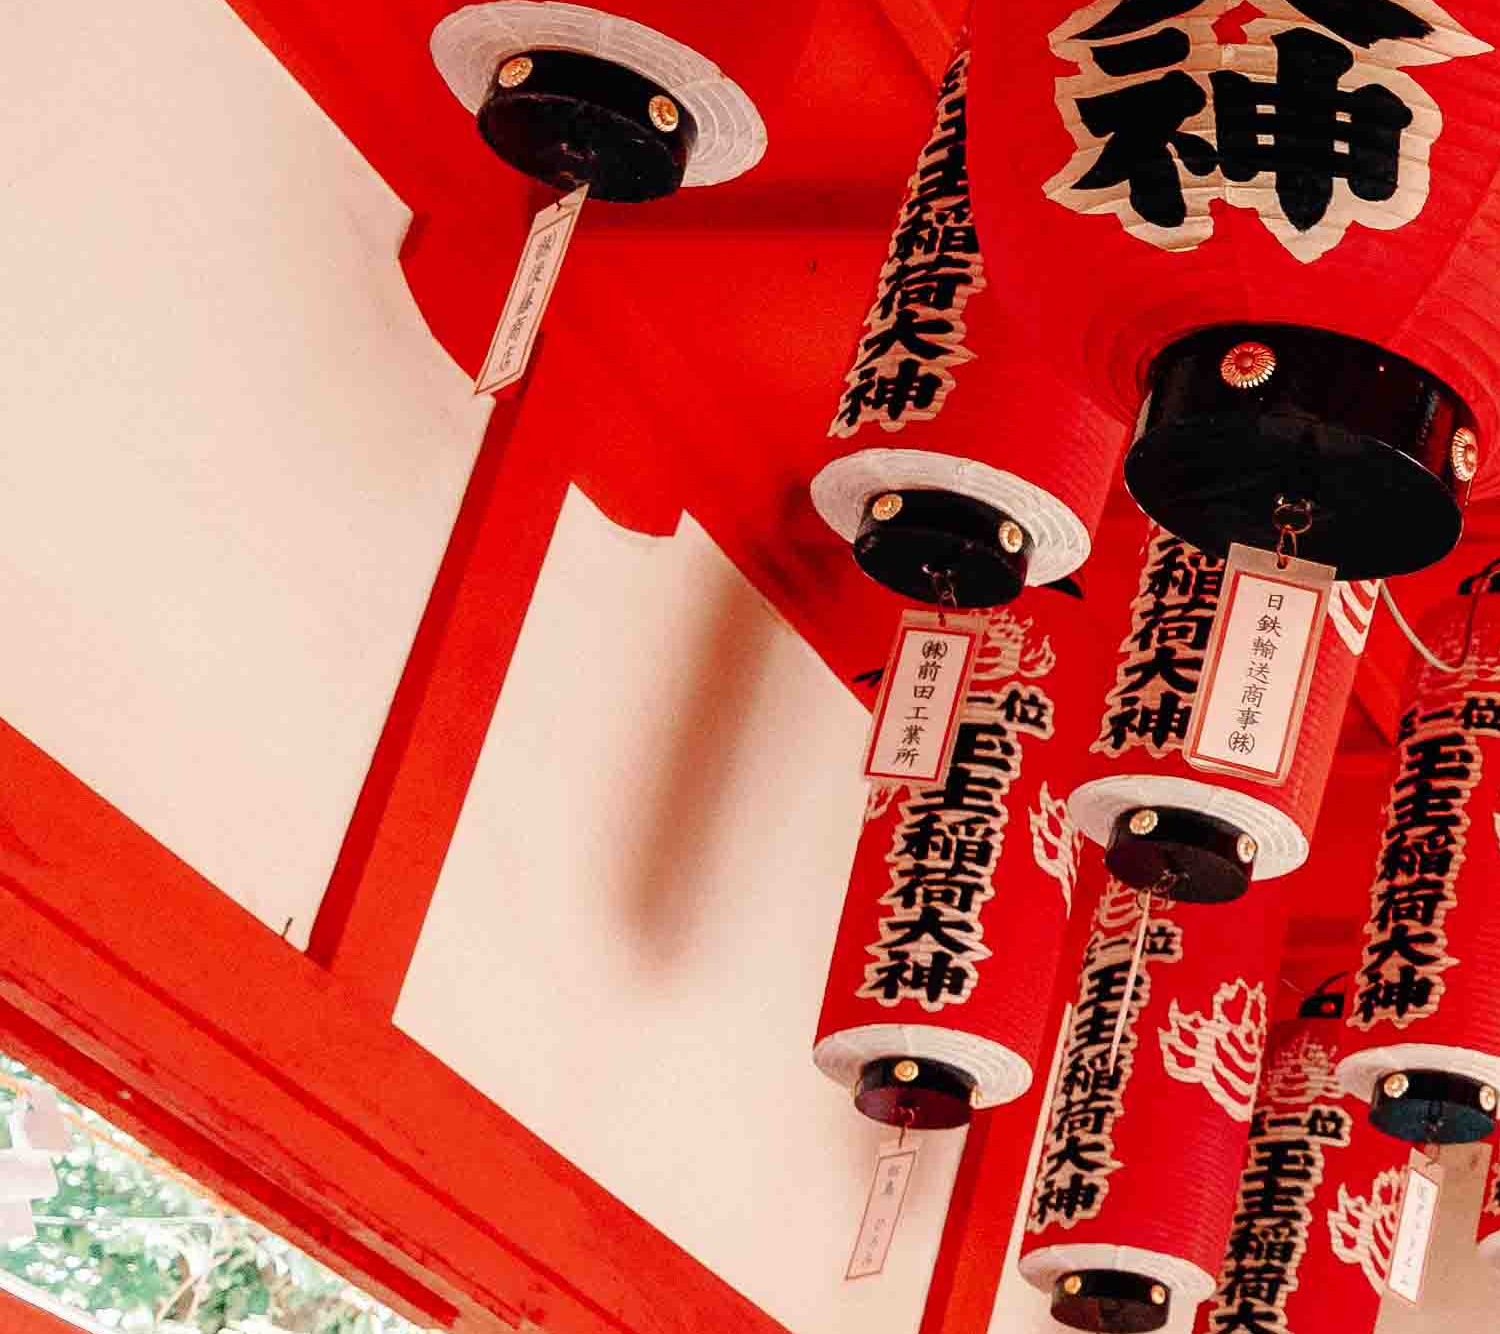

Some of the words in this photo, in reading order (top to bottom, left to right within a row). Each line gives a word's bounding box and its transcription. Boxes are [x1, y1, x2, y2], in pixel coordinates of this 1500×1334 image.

[966, 689, 1050, 729] 一位
[1108, 535, 1226, 751] 稲荷大神
[1356, 735, 1475, 1017] 玉主稲荷大神
